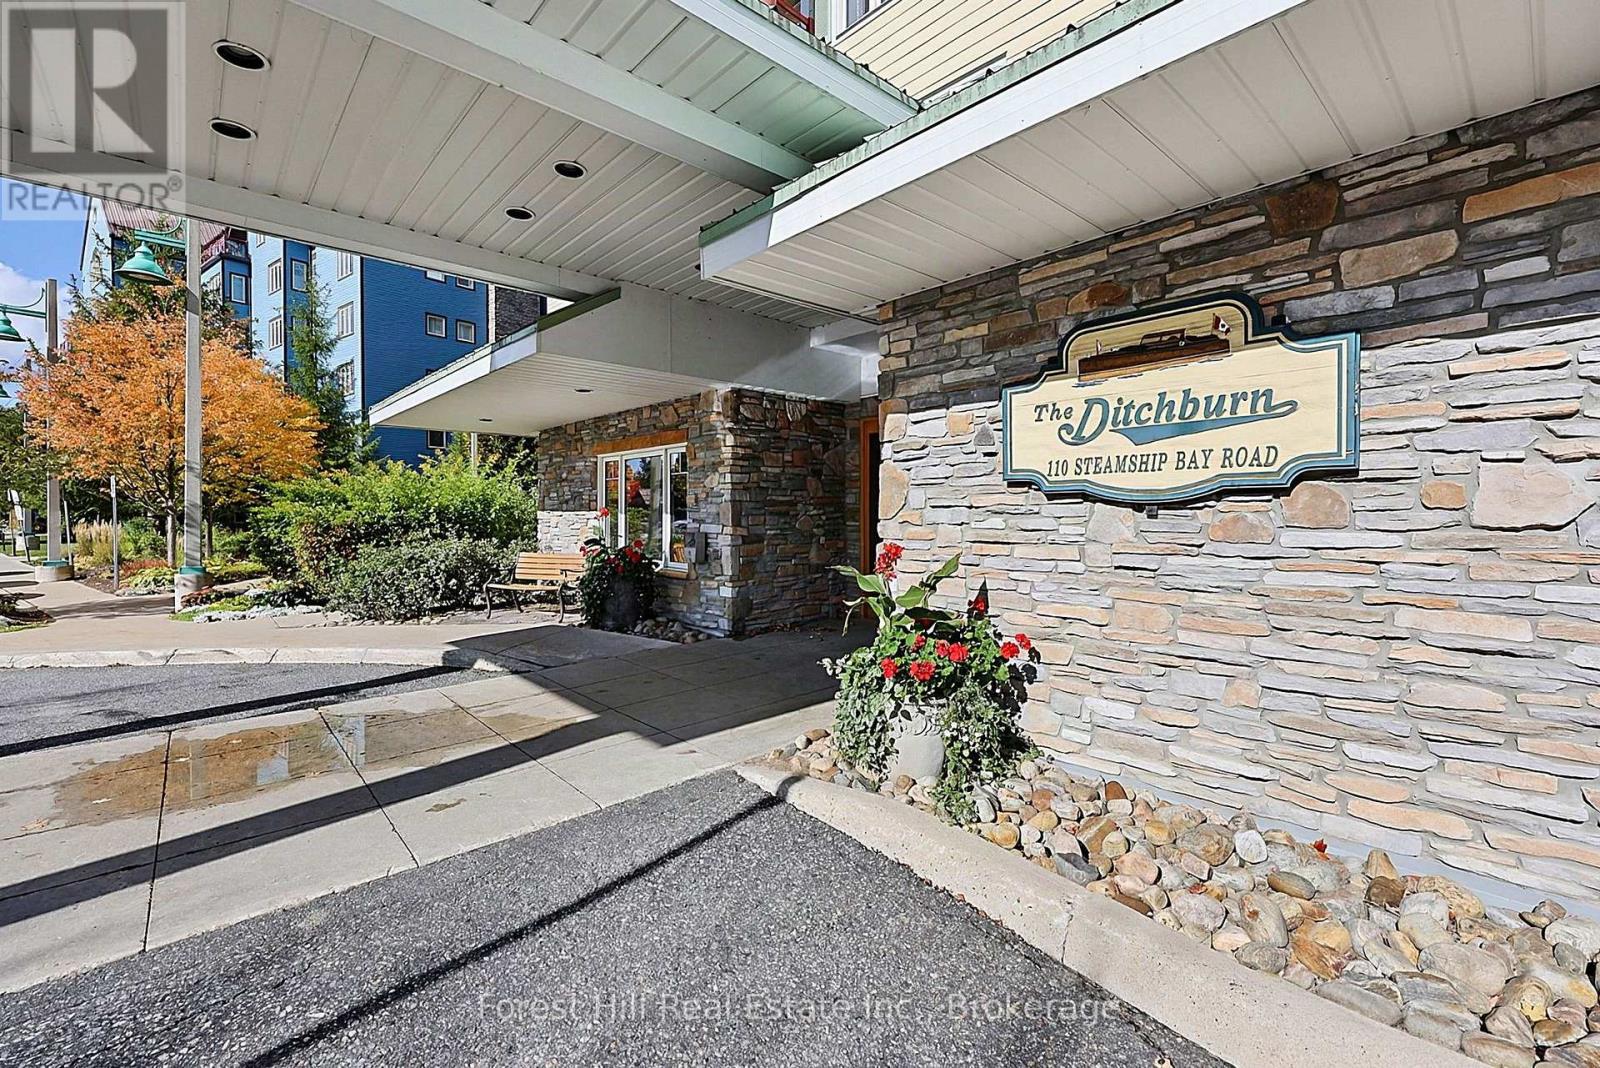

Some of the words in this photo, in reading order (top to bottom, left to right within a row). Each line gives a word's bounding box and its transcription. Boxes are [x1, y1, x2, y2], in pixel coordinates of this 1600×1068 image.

[1034, 403, 1074, 423] The
[1058, 387, 1298, 445] Ditchburn
[1047, 459, 1069, 477] 110
[1074, 453, 1168, 476] STEAMSHIP
[1175, 449, 1215, 471] BAY
[1221, 446, 1280, 469] ROAD
